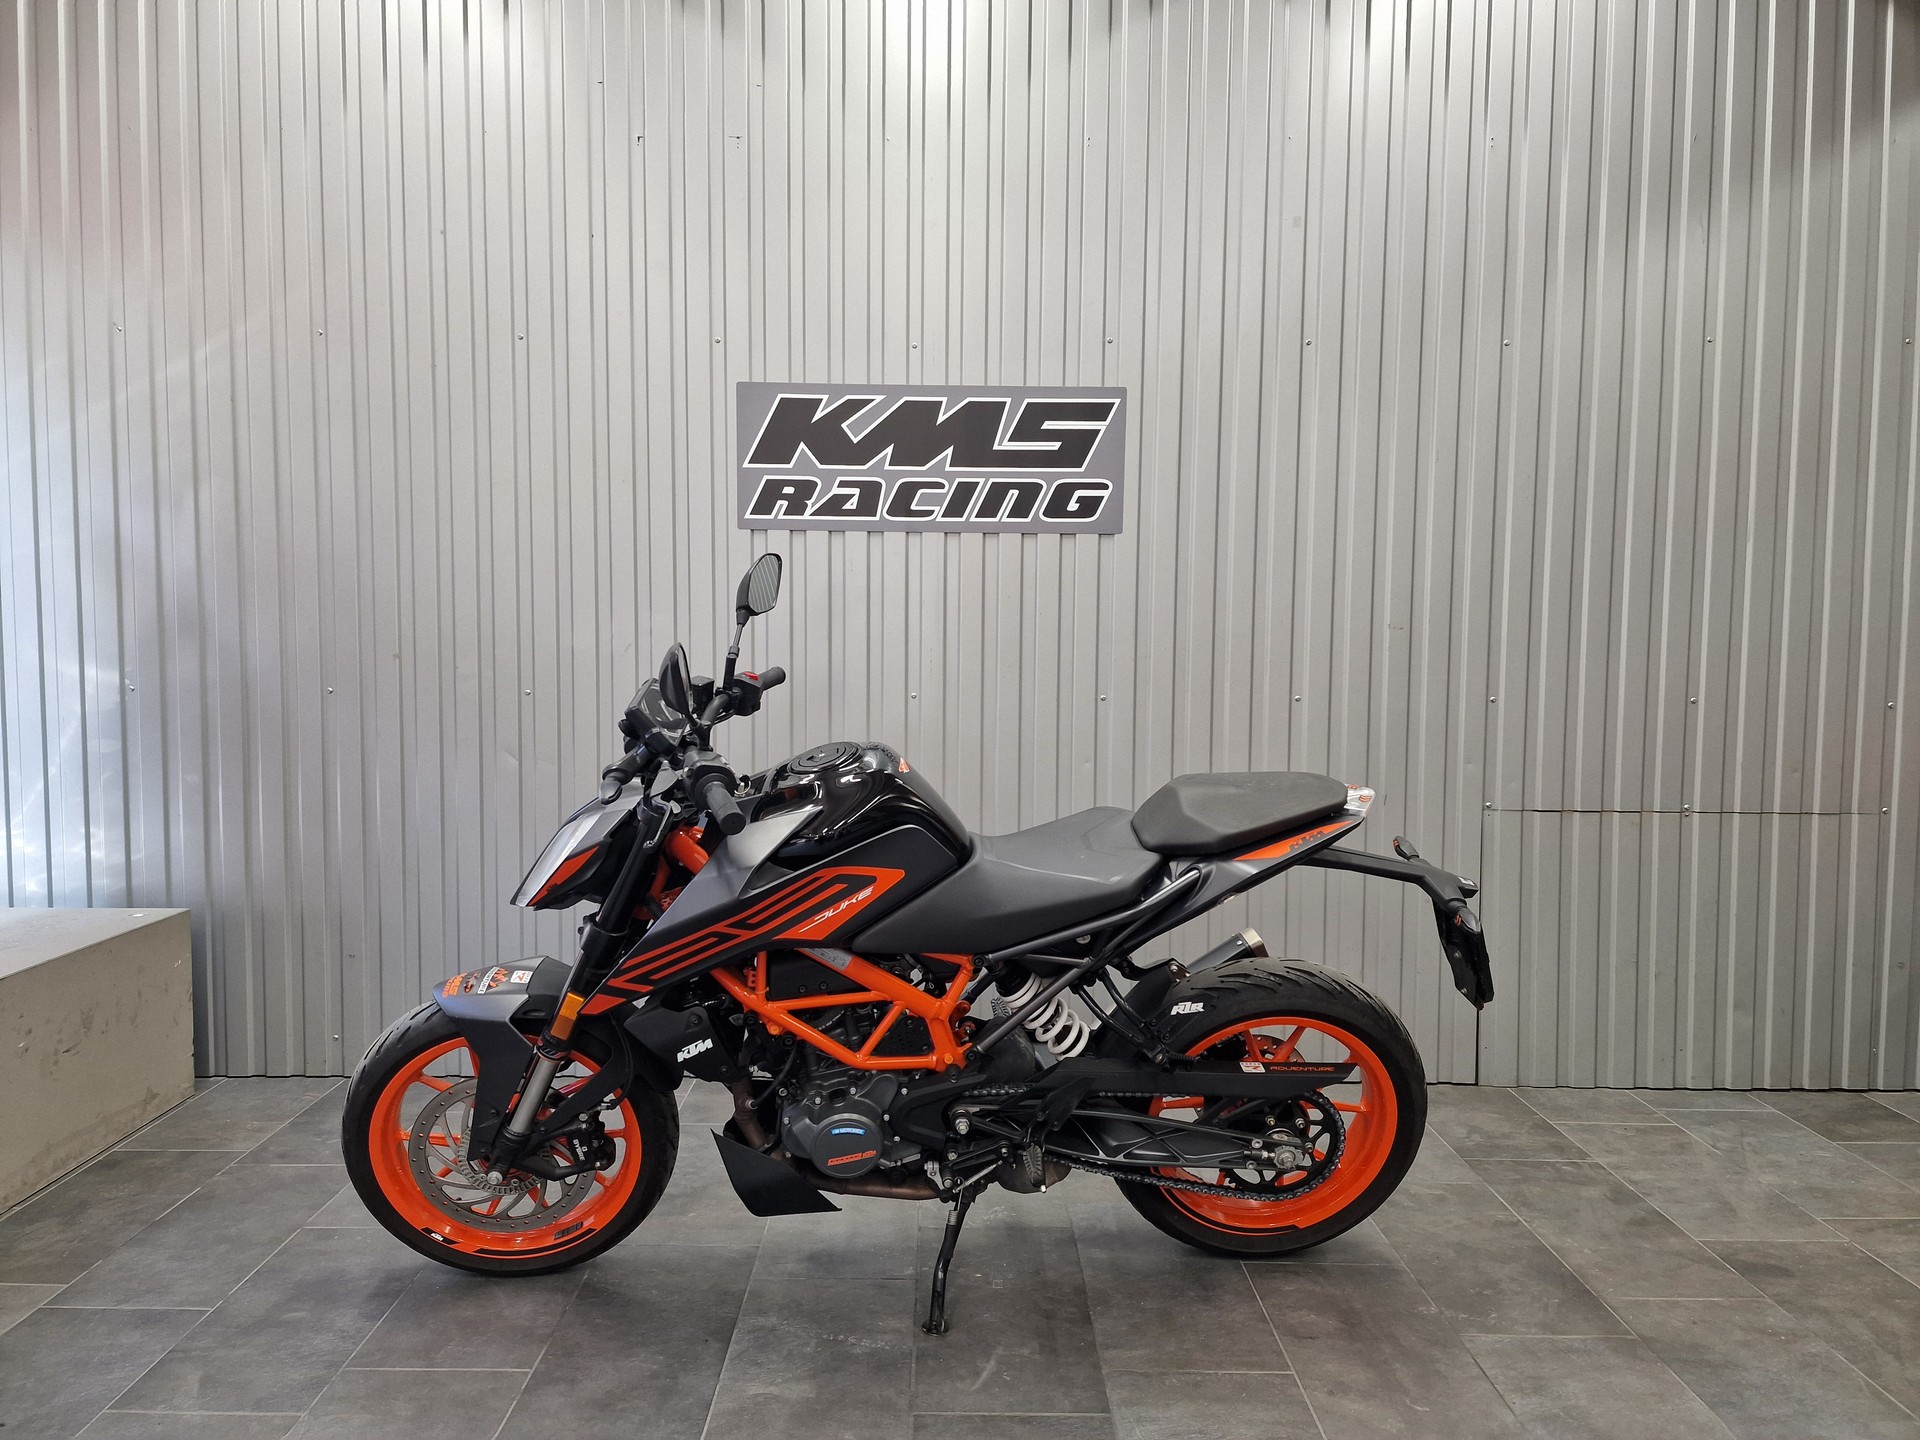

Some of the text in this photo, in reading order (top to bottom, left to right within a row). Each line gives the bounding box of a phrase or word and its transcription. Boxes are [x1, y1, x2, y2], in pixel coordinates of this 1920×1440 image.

[742, 393, 1122, 473] KMS
[743, 474, 1114, 523] RACING
[799, 886, 874, 932] DUKE
[677, 1037, 713, 1063] KTM
